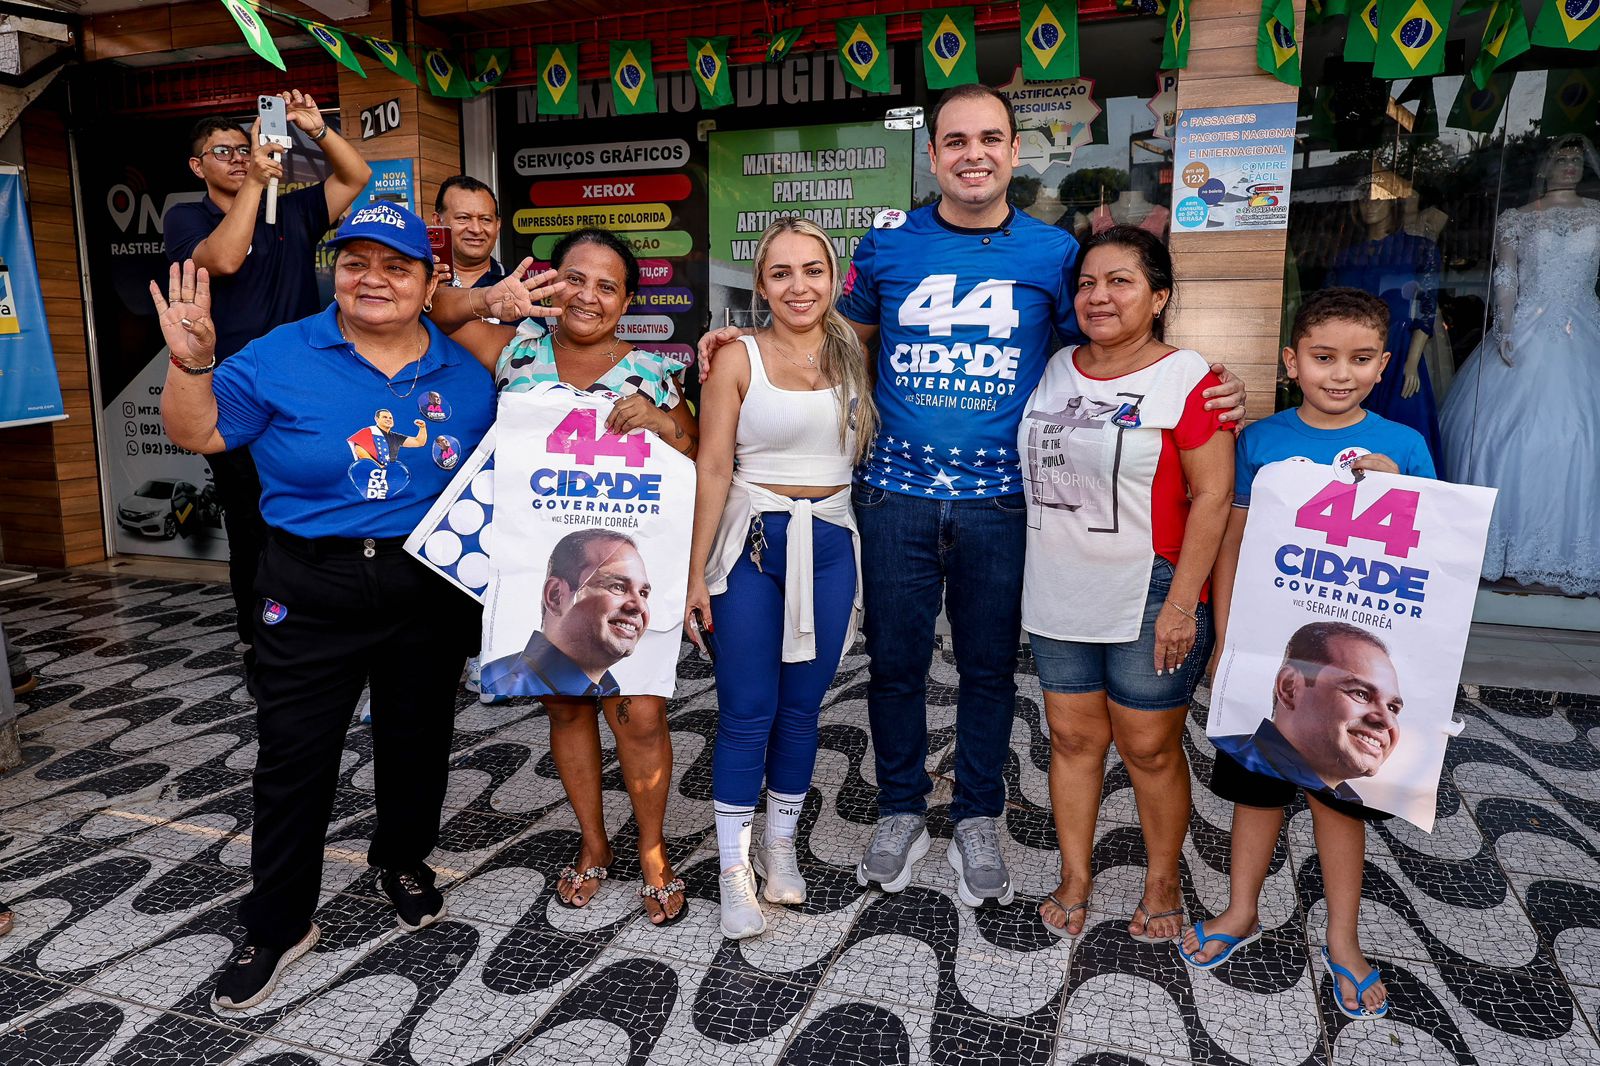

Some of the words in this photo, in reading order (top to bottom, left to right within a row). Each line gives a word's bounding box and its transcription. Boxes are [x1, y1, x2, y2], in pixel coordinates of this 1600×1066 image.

[1013, 101, 1072, 113] PESQUISAS
[361, 101, 399, 139] 210
[1190, 113, 1257, 127] PASSAGENS
[1189, 131, 1239, 143] PACOTES
[517, 150, 595, 169] SERVIÇOS
[599, 145, 683, 164] GRÁFICOS
[1189, 150, 1196, 159] E
[1199, 145, 1286, 158] INTERNACIONAL
[742, 151, 814, 176] MATERIAL
[817, 147, 886, 171] ESCOLAR
[1242, 161, 1287, 171] COMPRE
[375, 179, 407, 188] MOURA
[383, 172, 407, 180] NOVA
[1185, 174, 1205, 184] 12X
[582, 183, 635, 198] XEROX
[773, 178, 854, 203] PAPELARIA
[356, 205, 402, 220] ROBERTO
[517, 213, 574, 227] IMPRESSÕES
[576, 212, 606, 225] PRETO
[609, 213, 616, 225] E
[618, 211, 666, 225] COLORIDA
[803, 208, 844, 229] PARA
[351, 214, 406, 230] CIDADE
[650, 295, 692, 305] GERAL
[898, 274, 1019, 340] 44
[627, 324, 669, 334] NEGATIVAS
[889, 342, 1021, 381] CIDADE
[895, 375, 1016, 396] GOVERNADOR
[915, 393, 957, 409] SERAFIM
[960, 396, 997, 412] CORRÊA
[140, 422, 161, 436] (92)
[1043, 424, 1065, 434] QUEEN
[546, 407, 651, 468] 44
[141, 442, 162, 456] (92)
[1339, 449, 1358, 462] 44
[369, 468, 387, 480] CI
[367, 478, 389, 490] DA
[530, 467, 662, 501] CIDADE
[366, 488, 387, 500] DE
[532, 498, 660, 515] GOVERNADOR
[551, 515, 563, 523] VICE
[563, 514, 602, 526] SERAFIM
[604, 515, 639, 528] CORRÊA
[1294, 479, 1421, 559] 44
[1274, 543, 1430, 603] CIDADE
[1273, 576, 1423, 619] GOVERNADOR
[1292, 598, 1305, 608] VICE
[1305, 599, 1349, 620] SERAFIM
[1351, 610, 1393, 630] CORRÊA
